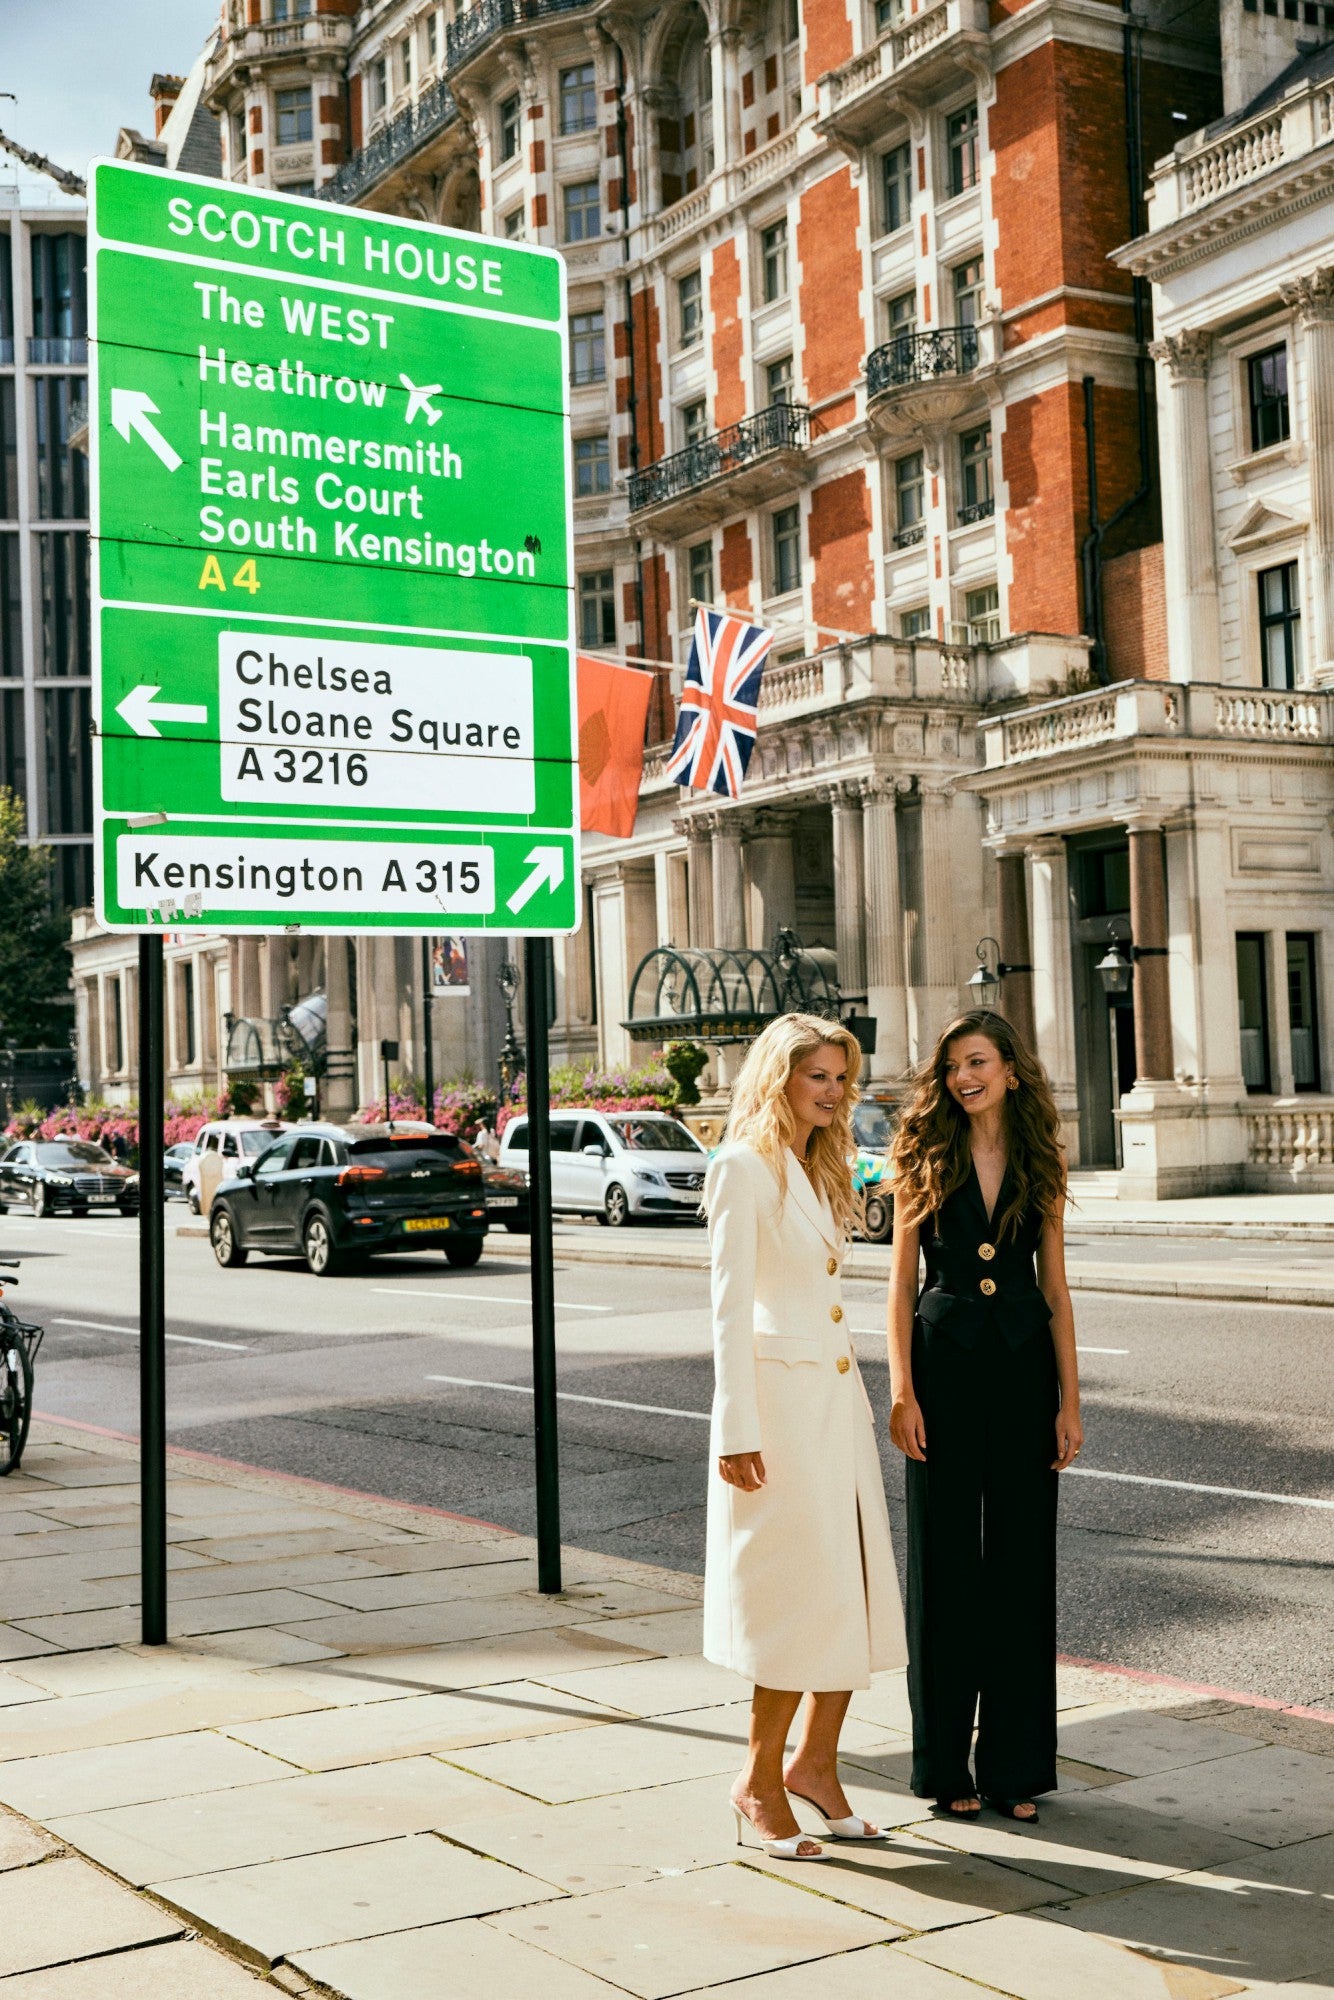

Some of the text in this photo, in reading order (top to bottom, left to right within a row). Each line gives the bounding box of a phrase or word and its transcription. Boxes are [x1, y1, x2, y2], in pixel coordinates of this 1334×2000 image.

[167, 197, 503, 297] SCOTCH HOUSE
[193, 281, 395, 350] The WEST
[198, 344, 387, 408] Heathrow
[199, 408, 462, 480] Hammersmith
[200, 456, 423, 520] Earls Court
[199, 505, 535, 578] South Kensington
[236, 650, 393, 695] Chelsea
[236, 698, 521, 750] Sloane Square
[135, 852, 363, 898] Kensington
